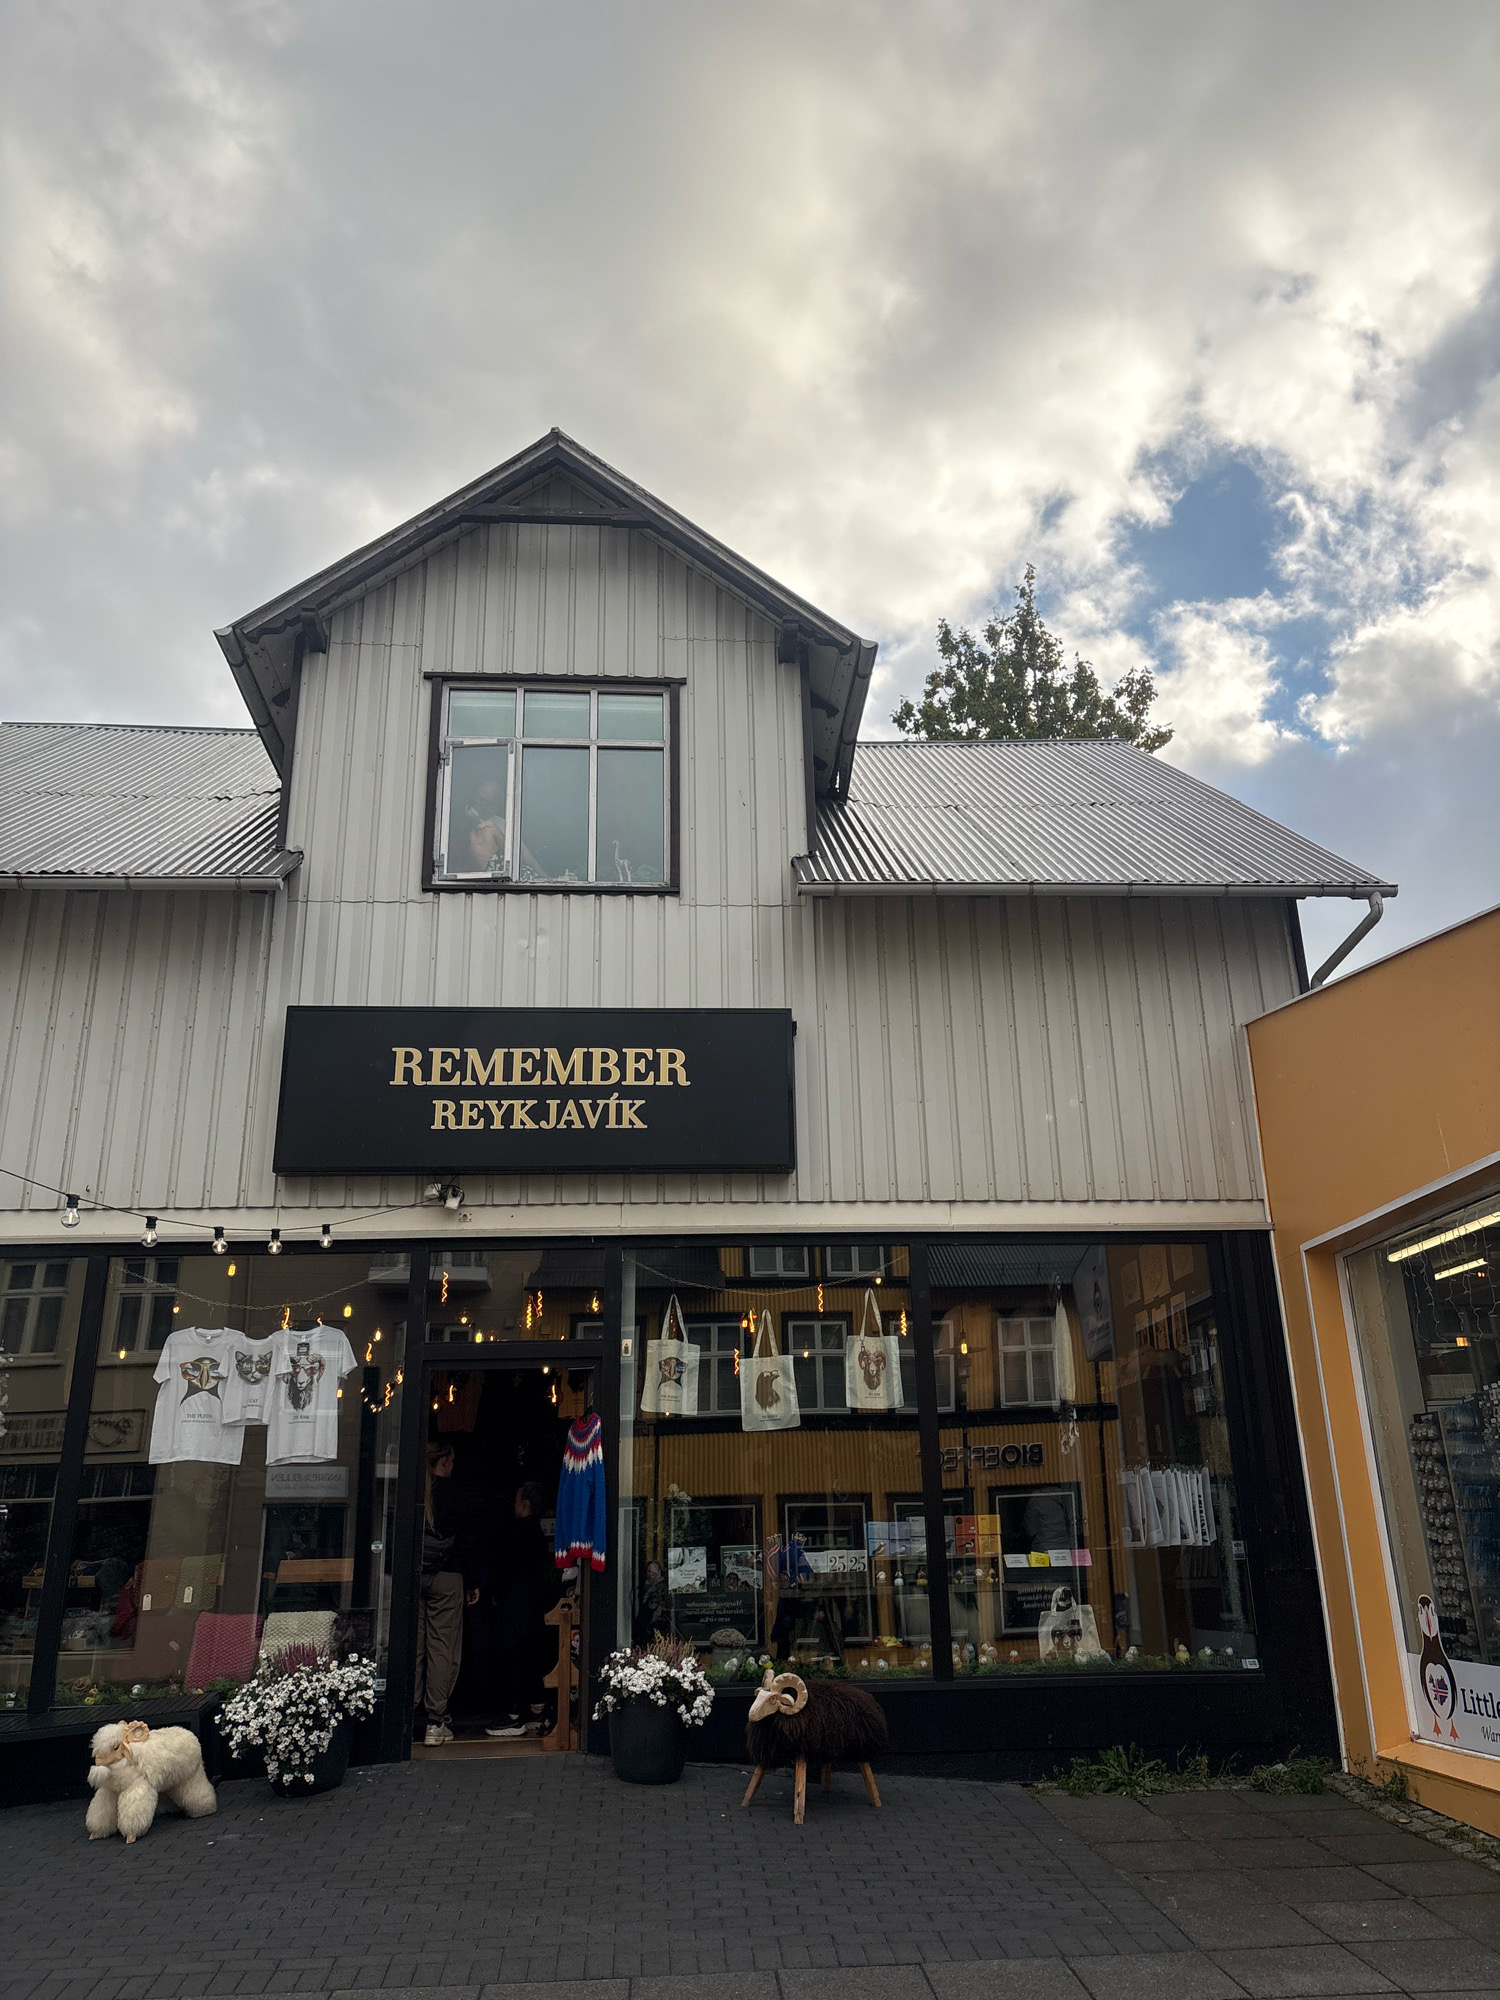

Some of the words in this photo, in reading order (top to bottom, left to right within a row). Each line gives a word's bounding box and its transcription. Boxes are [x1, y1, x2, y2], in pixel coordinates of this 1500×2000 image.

[389, 1046, 691, 1087] REMEMBER
[430, 1092, 648, 1130] REYKJAVÍK
[829, 1554, 847, 1573] 25
[849, 1555, 867, 1573] 25
[1480, 1725, 1500, 1743] War
